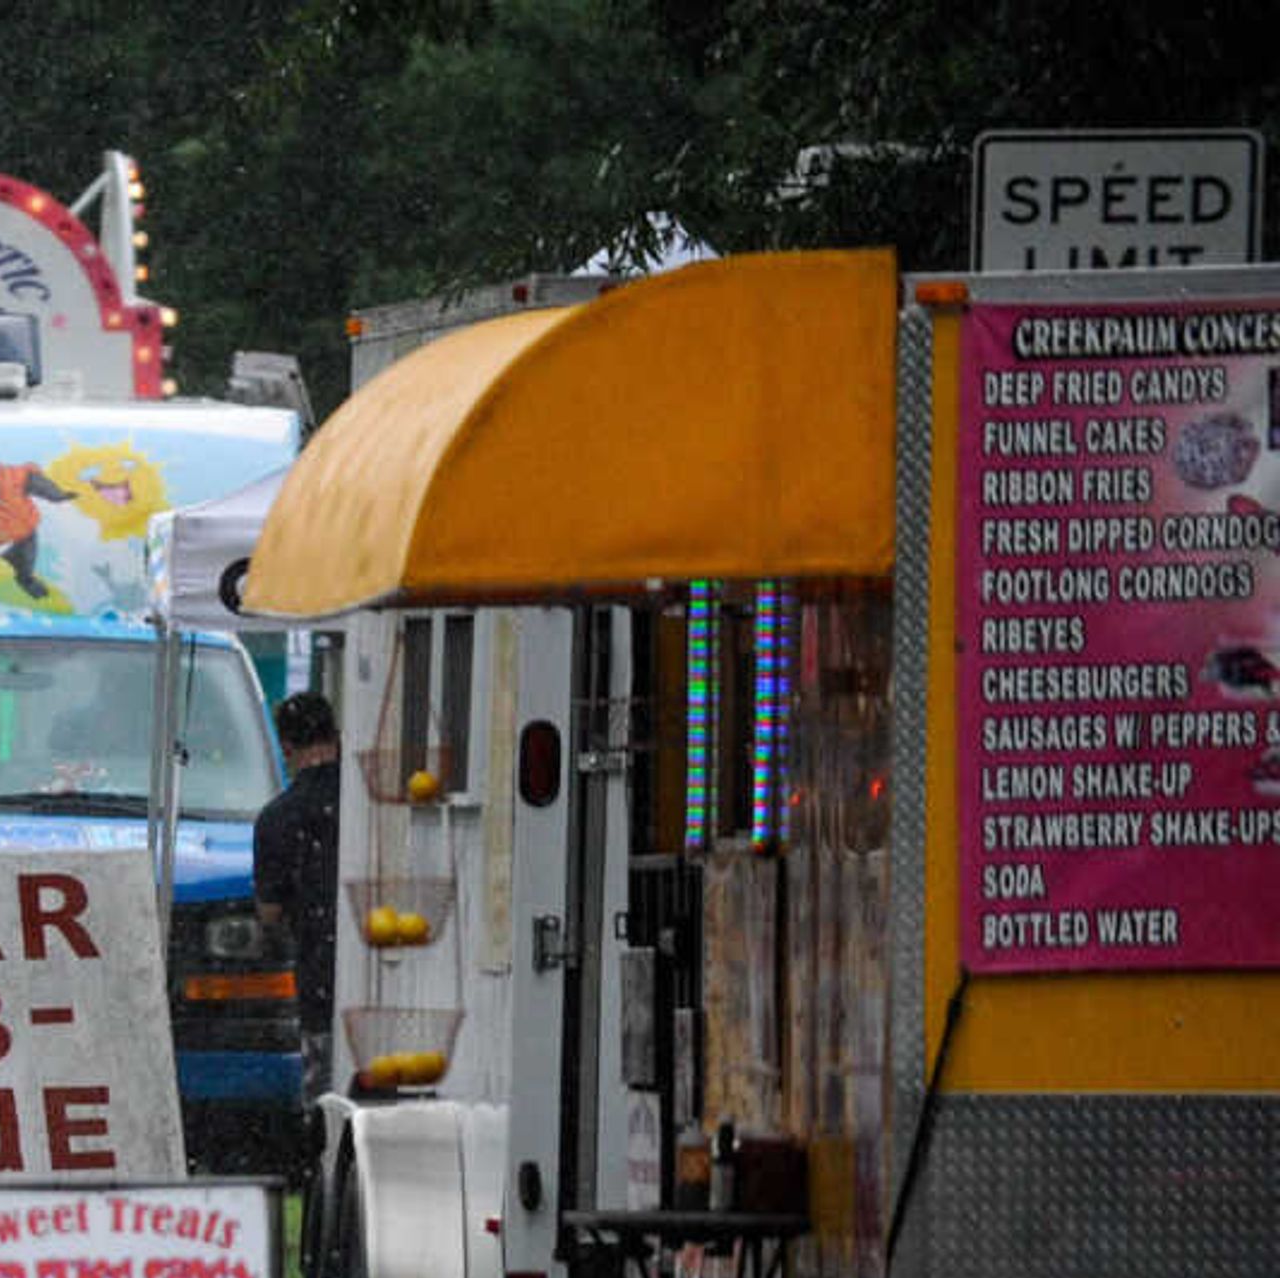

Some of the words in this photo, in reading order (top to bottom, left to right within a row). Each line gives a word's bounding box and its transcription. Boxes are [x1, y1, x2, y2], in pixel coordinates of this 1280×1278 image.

[1002, 175, 1232, 225] SPEED
[983, 371, 1044, 406] DEEP
[1052, 369, 1123, 404] FRIED
[1131, 366, 1226, 402] CANDYS
[983, 419, 1078, 456] FUNNEL
[1085, 417, 1166, 452] CAKES
[983, 470, 1074, 504] RIBBON
[1083, 468, 1151, 502] FRIES
[983, 518, 1060, 554] FRESH
[1068, 517, 1154, 551] DIPPED
[983, 566, 1110, 602] FOOTLONG
[1118, 563, 1253, 599] CORNDOGS
[983, 616, 1085, 652] RIBEYES
[983, 664, 1189, 701] CHEESEBURGERS
[983, 715, 1107, 750] SAUSAGES
[1150, 711, 1258, 747] PEPPERS
[983, 765, 1064, 800] LEMON
[1072, 762, 1193, 798] SHAKE-UP
[983, 813, 1143, 849] STRAWBERRY
[983, 863, 1046, 899] SODA
[983, 911, 1090, 948] BOTTLED
[1096, 909, 1179, 945] WATER
[105, 1196, 240, 1250] Treats
